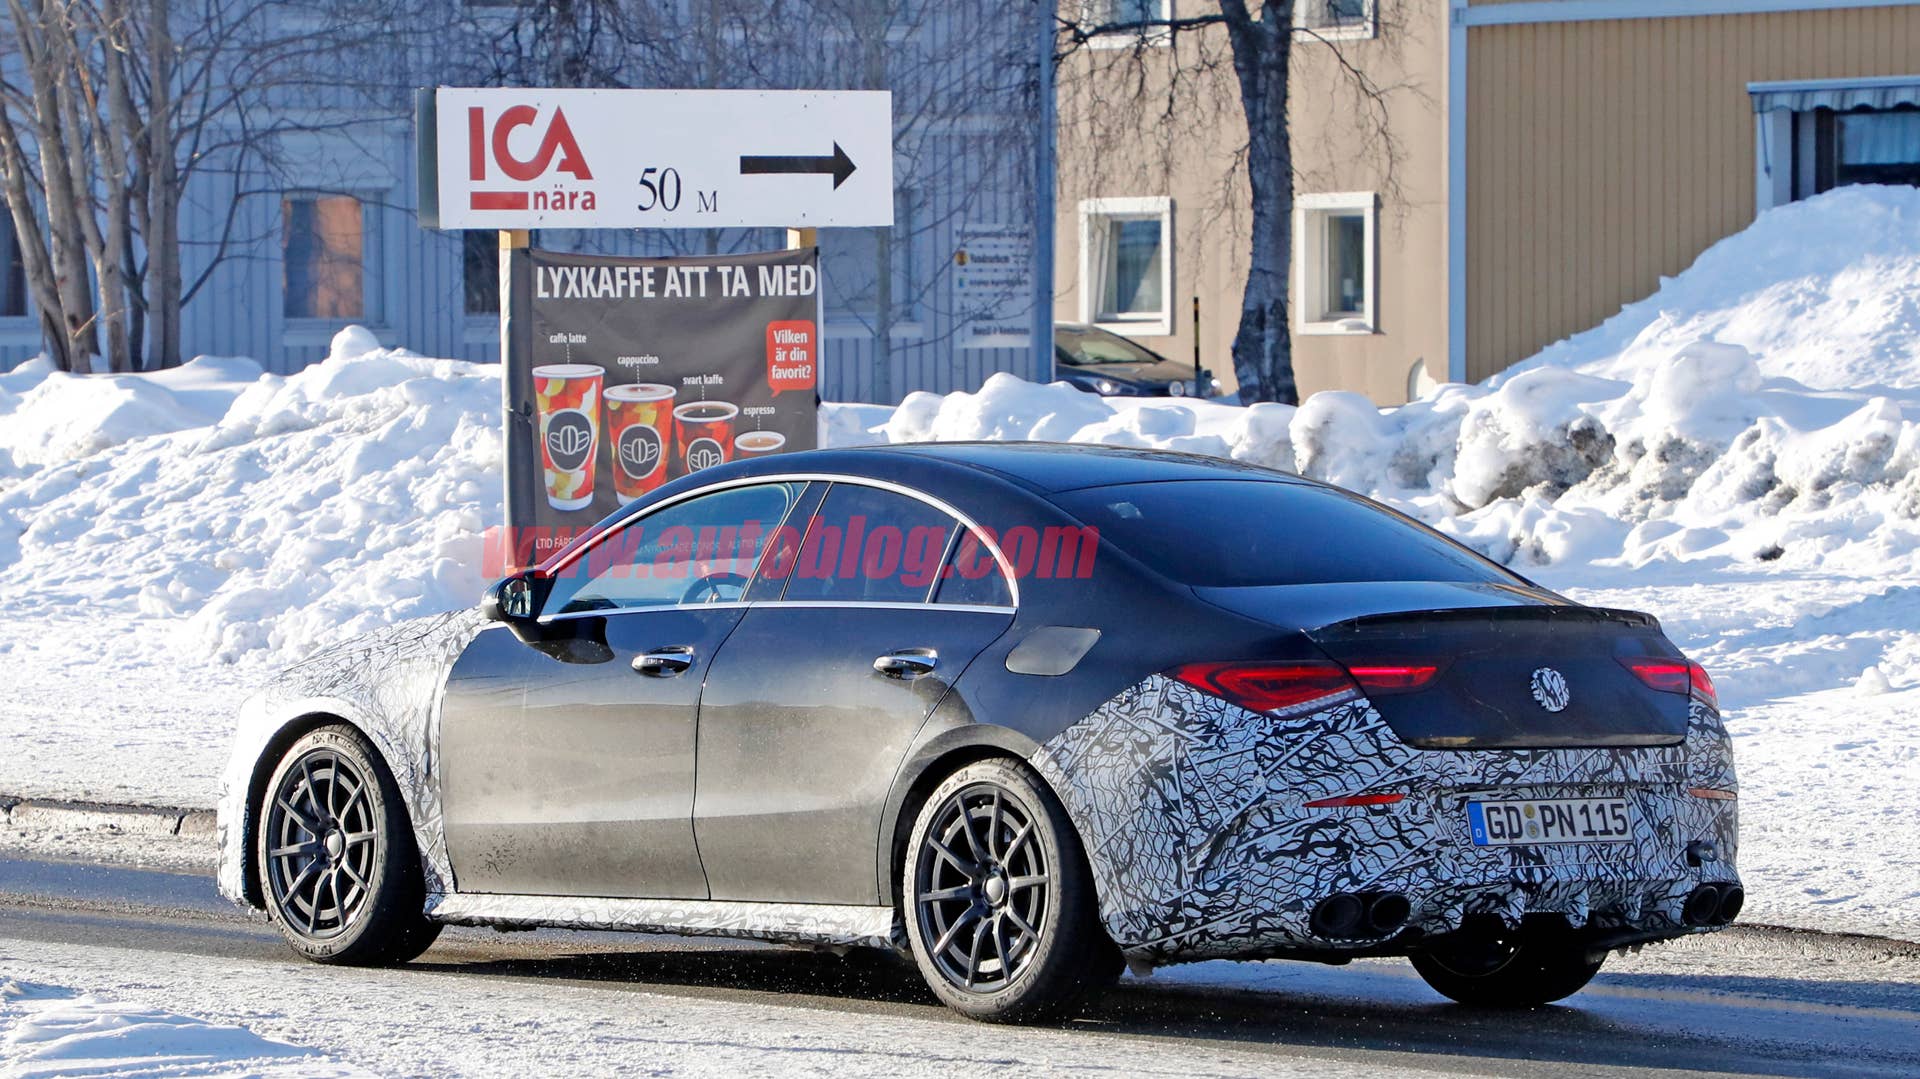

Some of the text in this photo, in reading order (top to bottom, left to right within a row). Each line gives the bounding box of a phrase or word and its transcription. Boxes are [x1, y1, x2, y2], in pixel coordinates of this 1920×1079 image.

[468, 105, 593, 181] ICA
[533, 184, 596, 210] nära
[637, 167, 718, 213] 50 M
[536, 265, 817, 299] LYXKAFFE ATT TA MED
[568, 333, 587, 344] latte
[773, 329, 808, 345] Vilken
[617, 354, 659, 366] cappuccino
[775, 345, 807, 361] är din
[771, 363, 811, 380] favorit?
[683, 374, 723, 386] svart kaffe
[743, 405, 775, 416] espresso
[1486, 803, 1628, 839] GD PN 115
